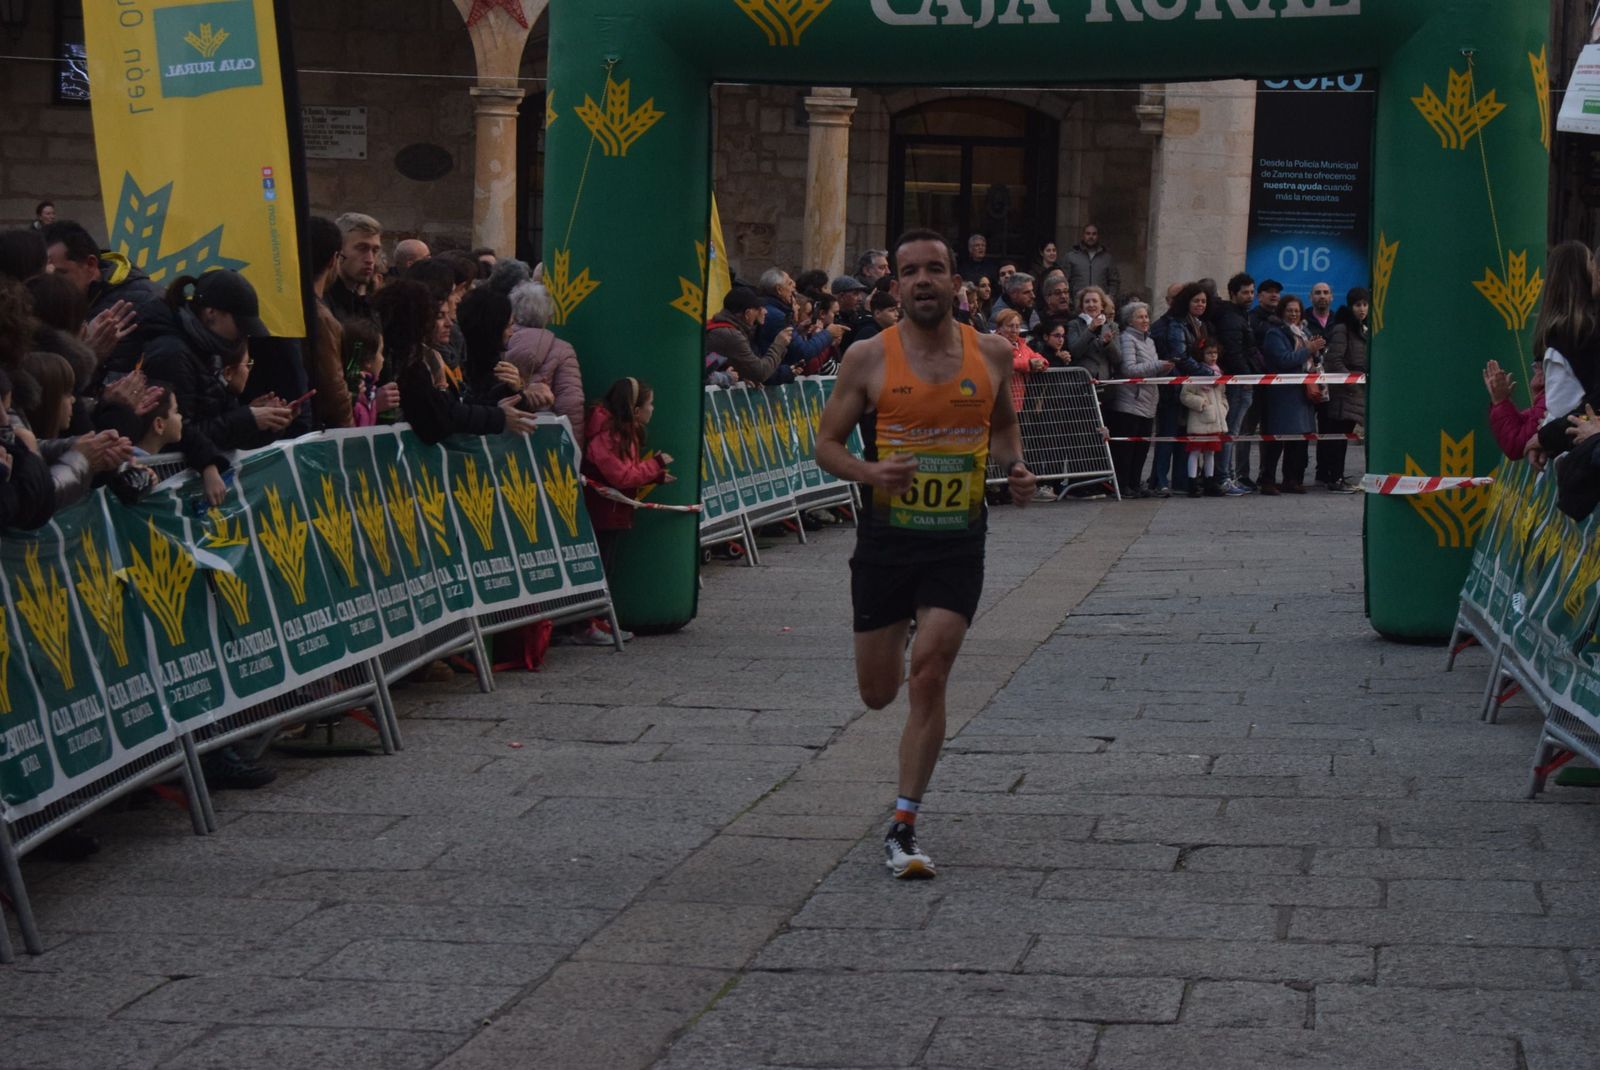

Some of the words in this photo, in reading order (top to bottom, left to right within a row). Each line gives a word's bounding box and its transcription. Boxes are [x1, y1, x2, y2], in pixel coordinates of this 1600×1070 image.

[1259, 158, 1285, 167] Desde
[1286, 159, 1293, 167] la
[1294, 159, 1320, 168] Policía
[1321, 160, 1359, 170] Municipal
[1261, 170, 1272, 178] de
[1272, 170, 1304, 179] Zamora
[1304, 171, 1313, 179] te
[1313, 171, 1357, 181] ofrecemos
[1263, 182, 1296, 190] nuestra
[1297, 183, 1322, 192] ayuda
[1322, 183, 1353, 192] cuando
[1275, 192, 1293, 201] más
[1293, 193, 1301, 201] la
[1301, 194, 1340, 203] necesitas
[1278, 245, 1331, 272] 016
[900, 477, 963, 508] 602
[912, 515, 936, 525] CAJA
[160, 659, 183, 688] AJA
[178, 649, 216, 679] RURAL
